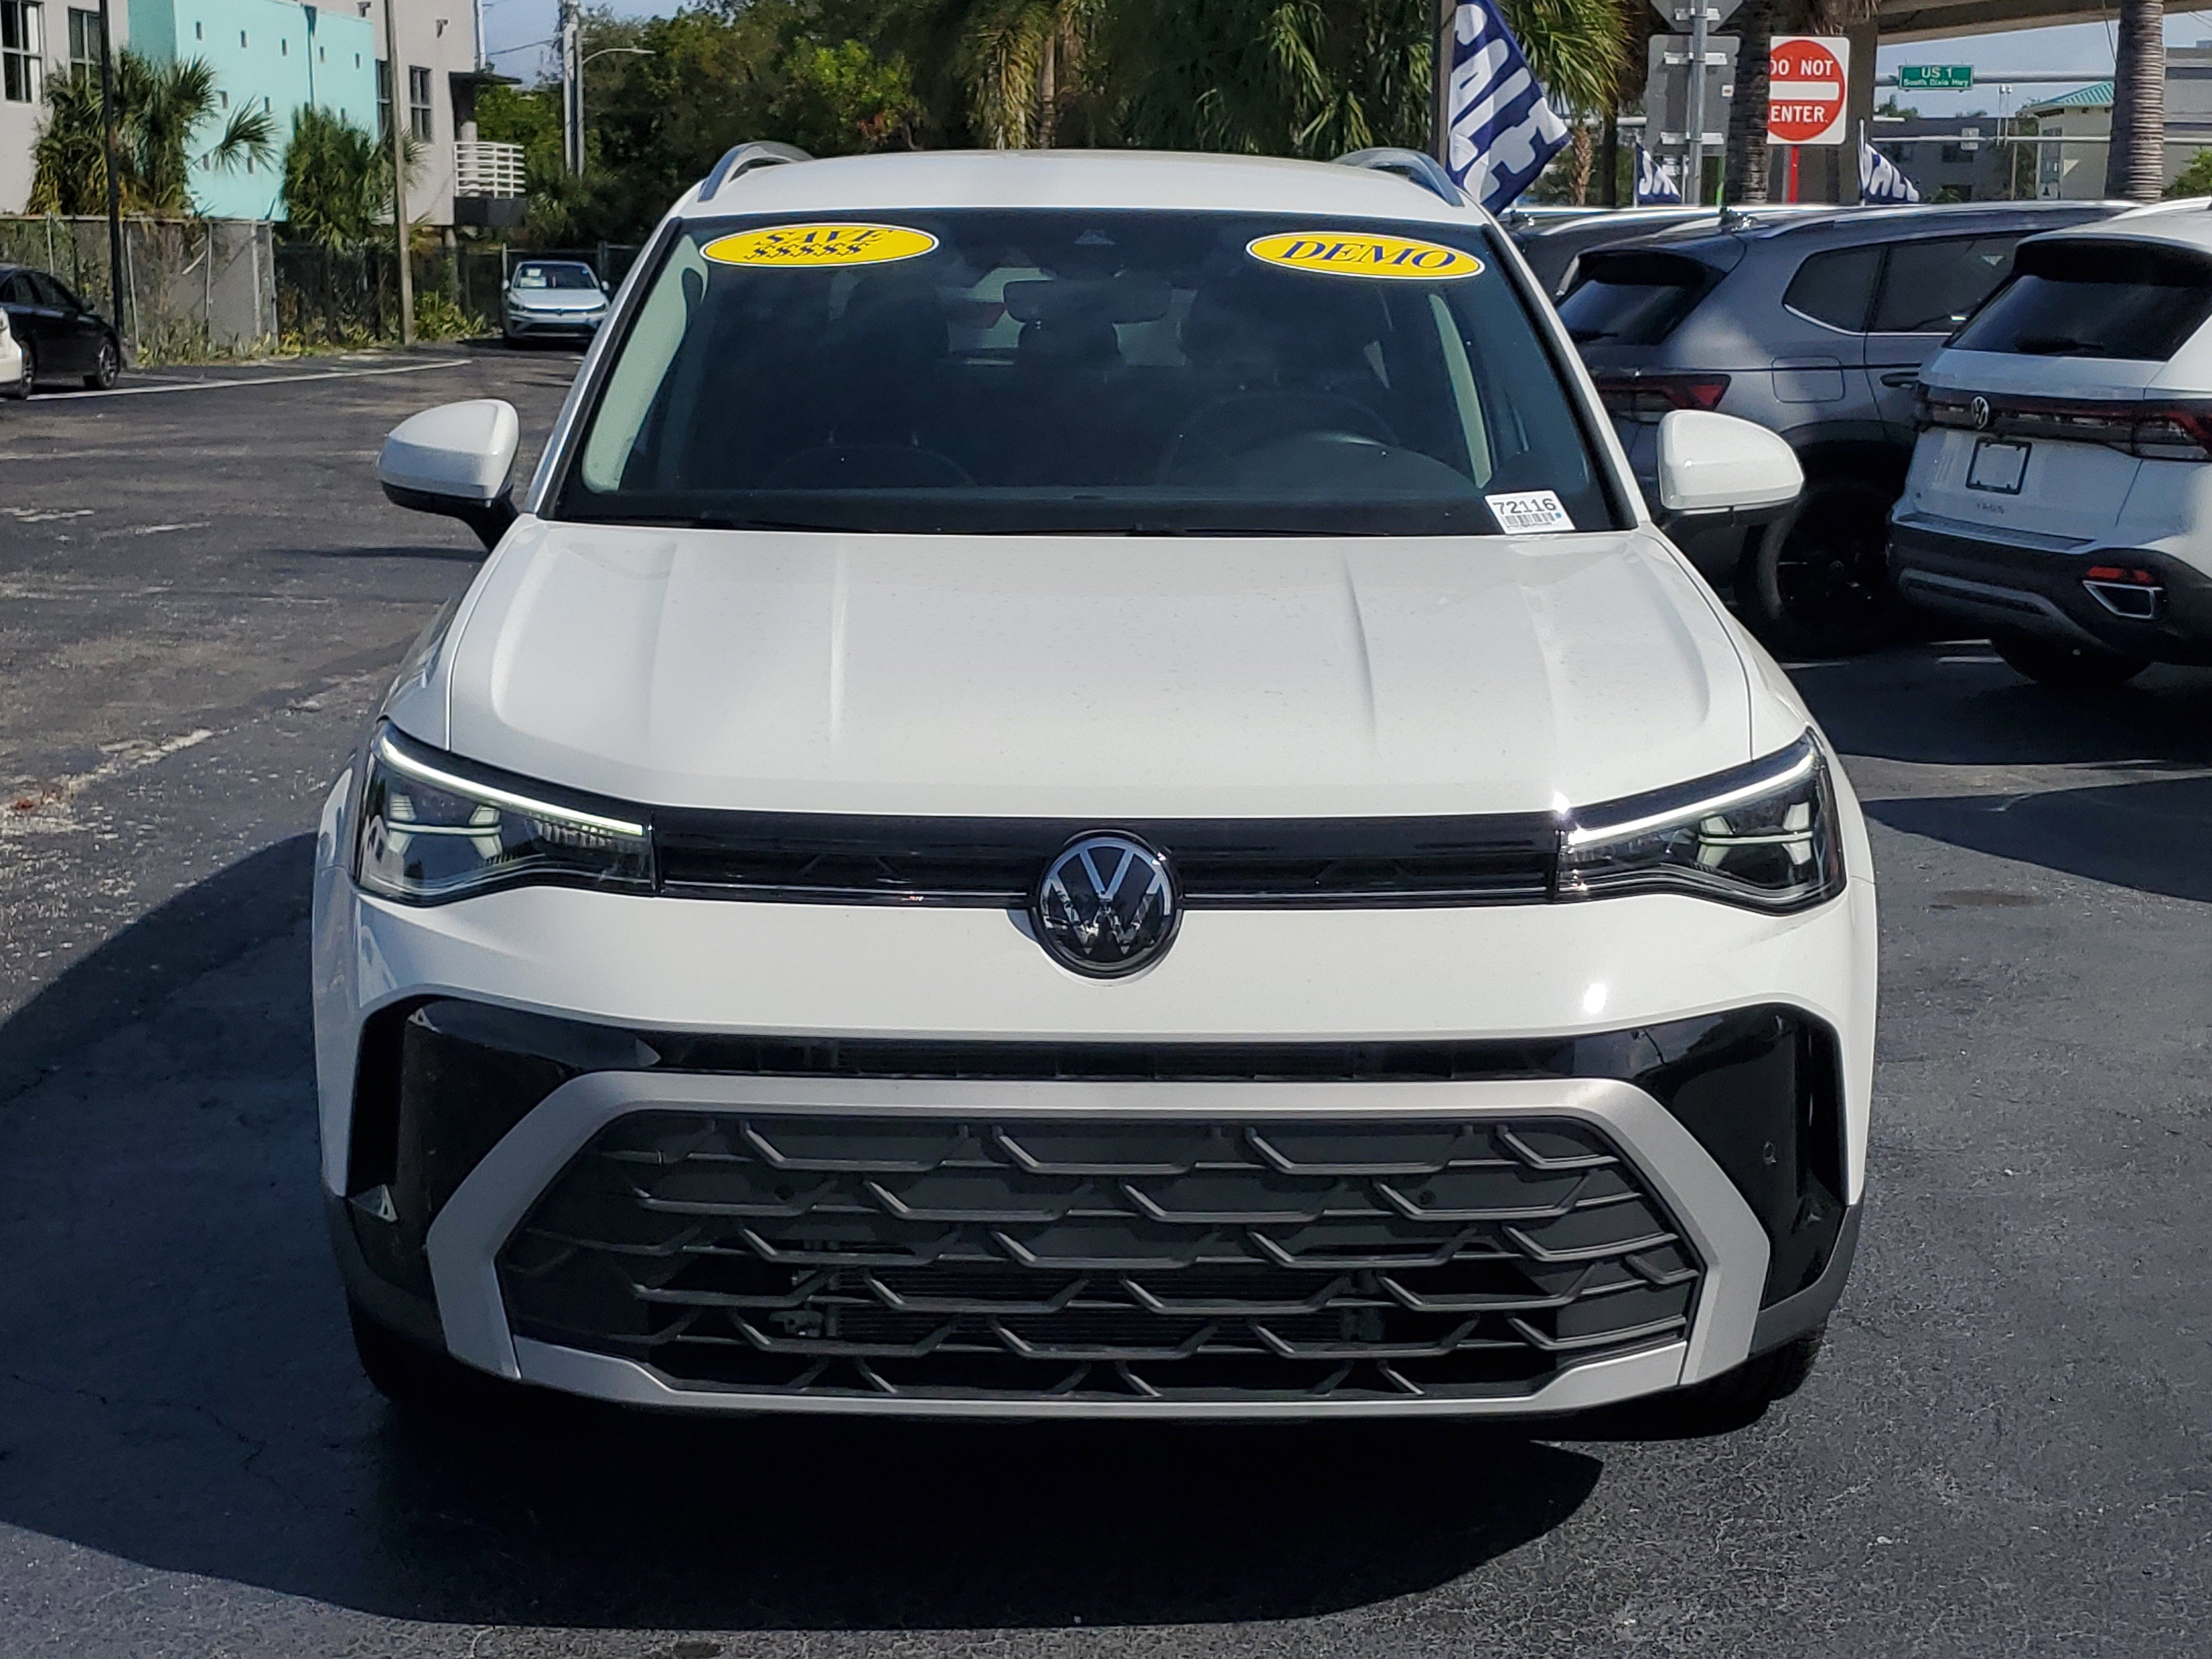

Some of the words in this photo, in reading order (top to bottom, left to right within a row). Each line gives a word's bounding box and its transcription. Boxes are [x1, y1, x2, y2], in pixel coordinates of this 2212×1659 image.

[1800, 59, 1834, 76] NOT
[1922, 66, 1941, 78] US
[1946, 67, 1952, 78] 1
[1770, 105, 1826, 122] ENTER
[753, 229, 894, 245] SAVE
[1276, 240, 1456, 269] DEMO
[1492, 498, 1556, 515] 72116
